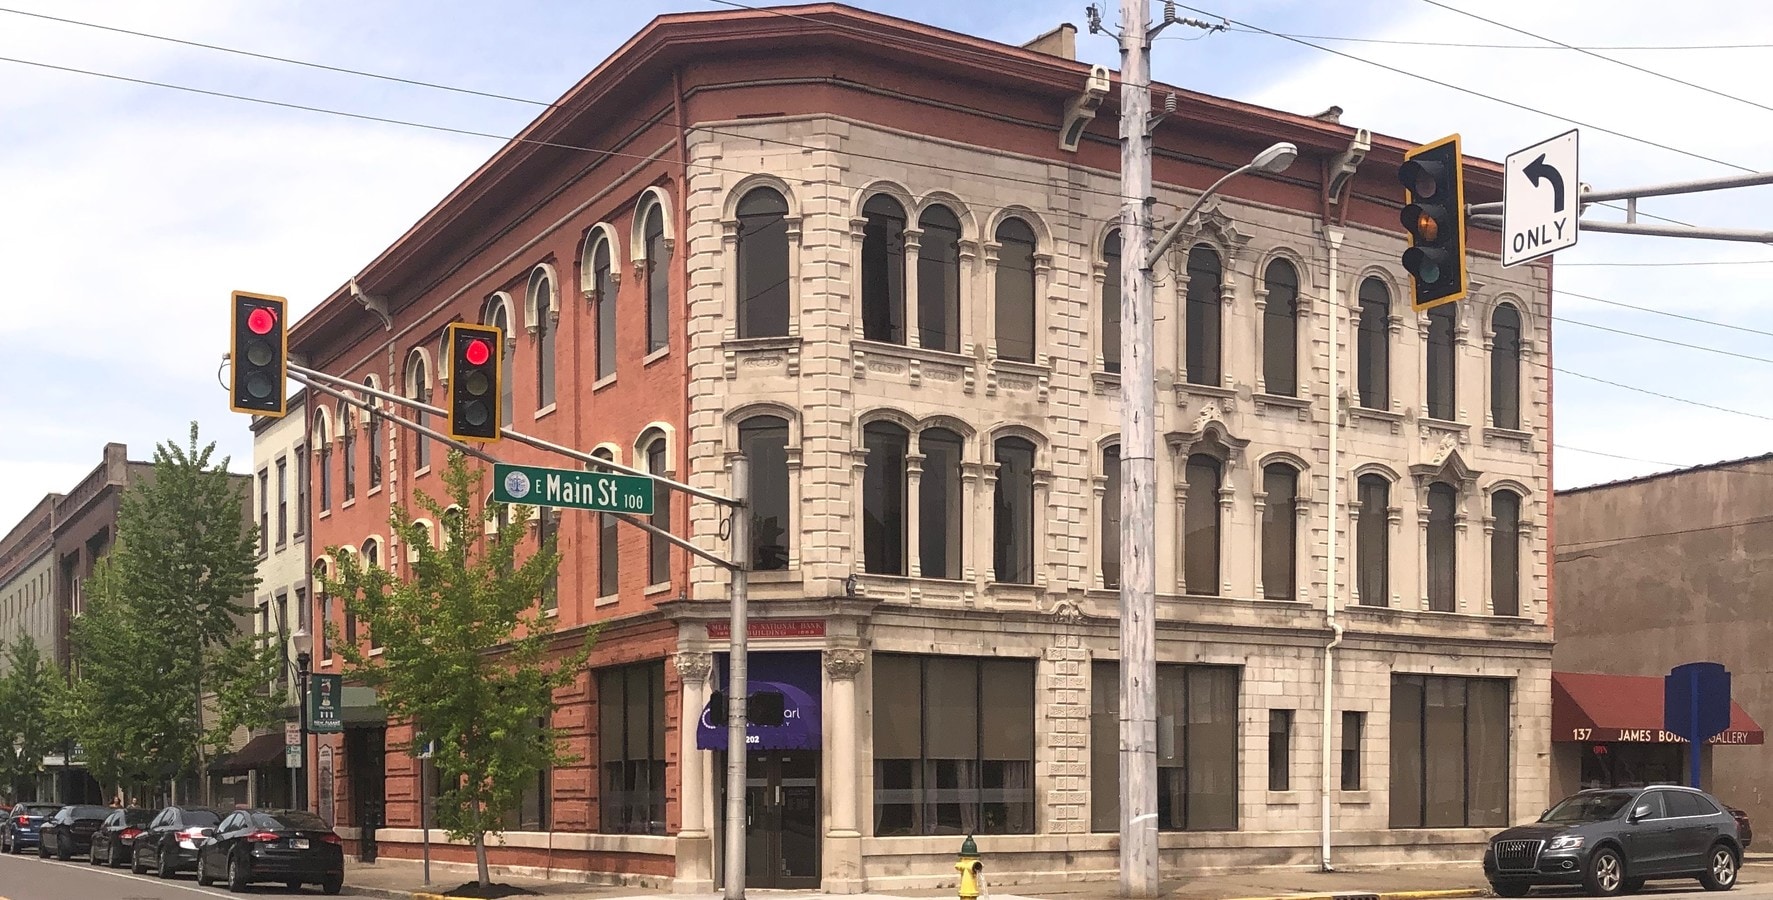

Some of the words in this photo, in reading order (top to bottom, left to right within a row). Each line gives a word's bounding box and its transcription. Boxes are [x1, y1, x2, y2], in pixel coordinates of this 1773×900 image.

[1513, 217, 1567, 253] ONLY
[535, 479, 542, 494] E
[546, 473, 593, 505] Main
[598, 478, 618, 507] St
[624, 494, 643, 510] 100
[761, 622, 797, 630] NATIONAL
[800, 622, 823, 630] BANK
[783, 707, 800, 719] arl
[746, 735, 760, 744] 202
[1573, 728, 1592, 741] 137
[1617, 729, 1651, 742] JAMES
[1708, 731, 1748, 744] GALLERY
